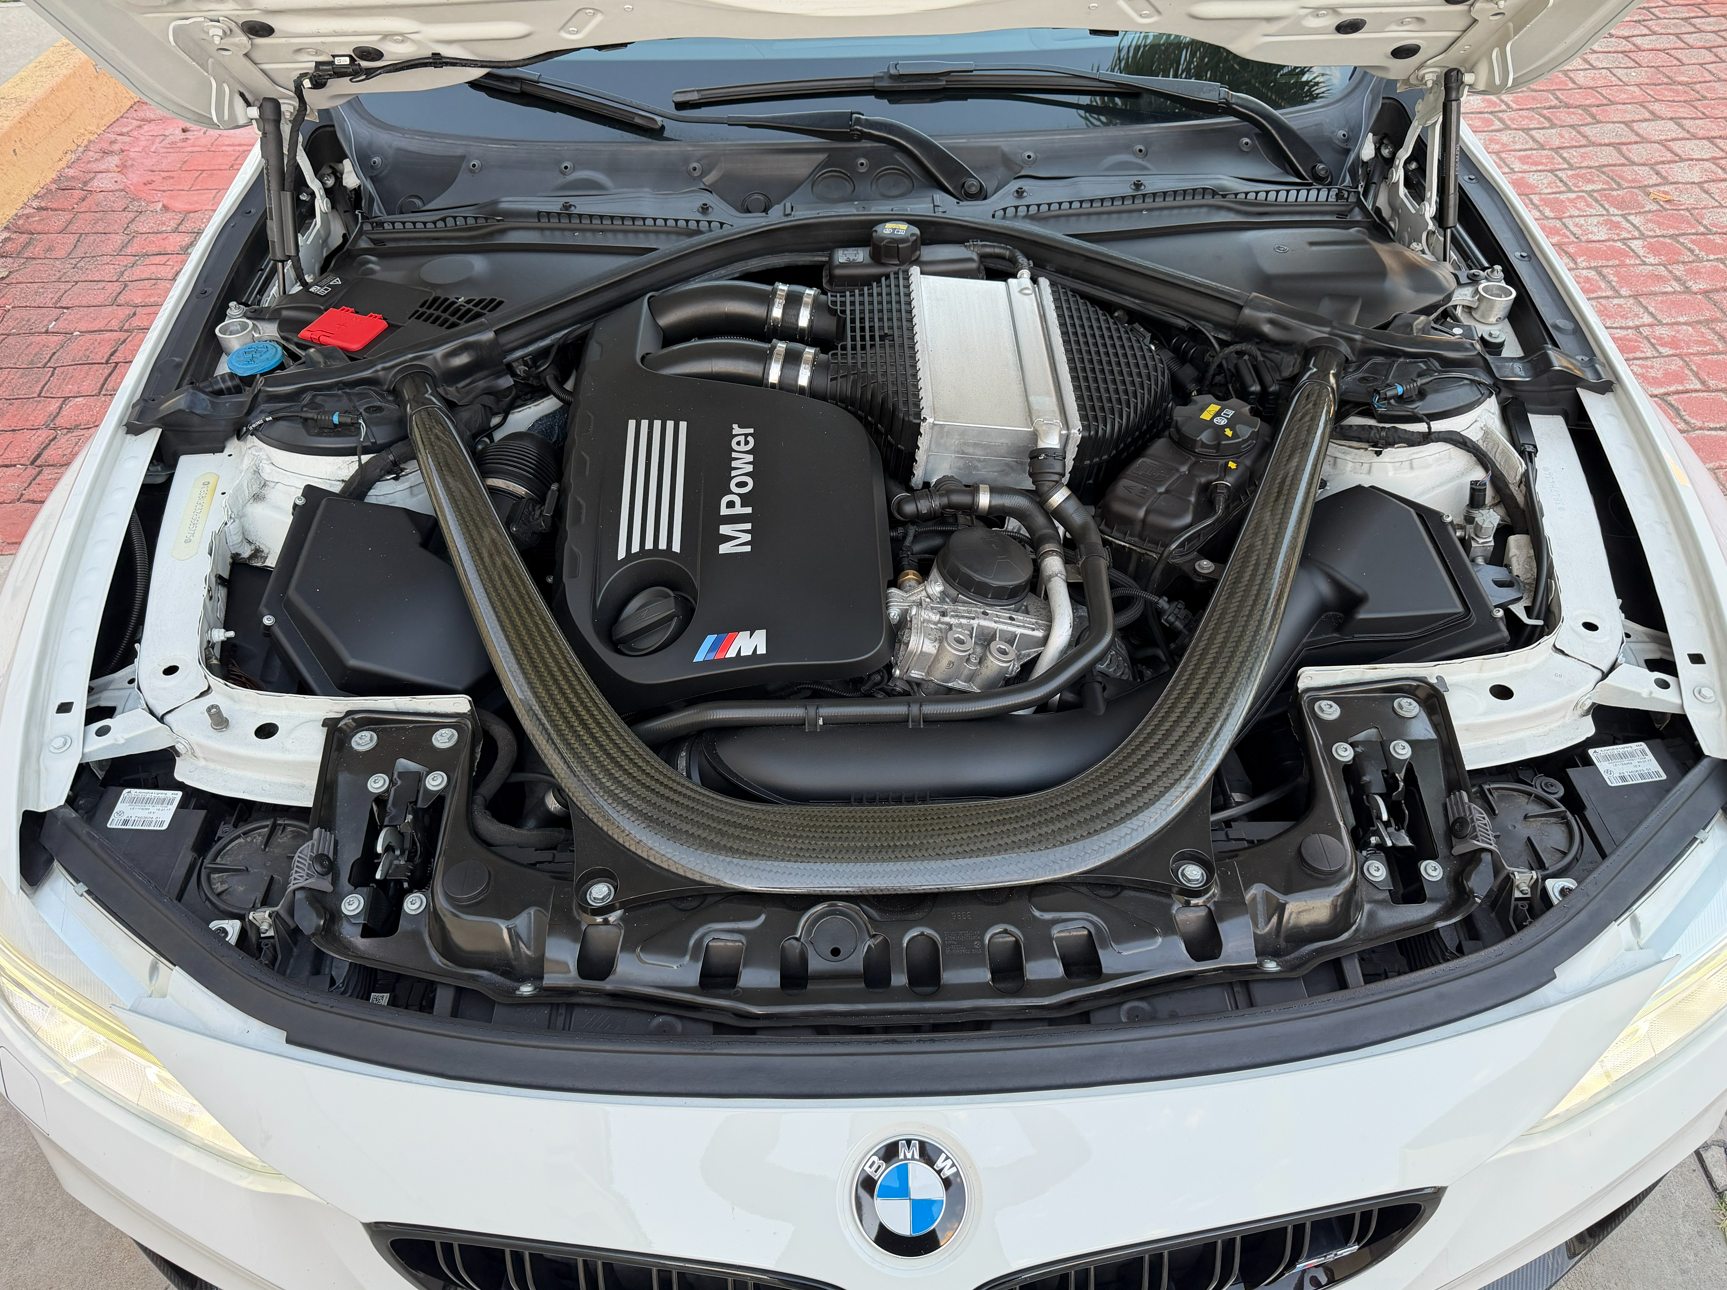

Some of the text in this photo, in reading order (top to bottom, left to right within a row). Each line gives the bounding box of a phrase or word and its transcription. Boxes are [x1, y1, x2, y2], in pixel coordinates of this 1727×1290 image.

[719, 423, 755, 554] M Power
[863, 1140, 958, 1180] BMW
